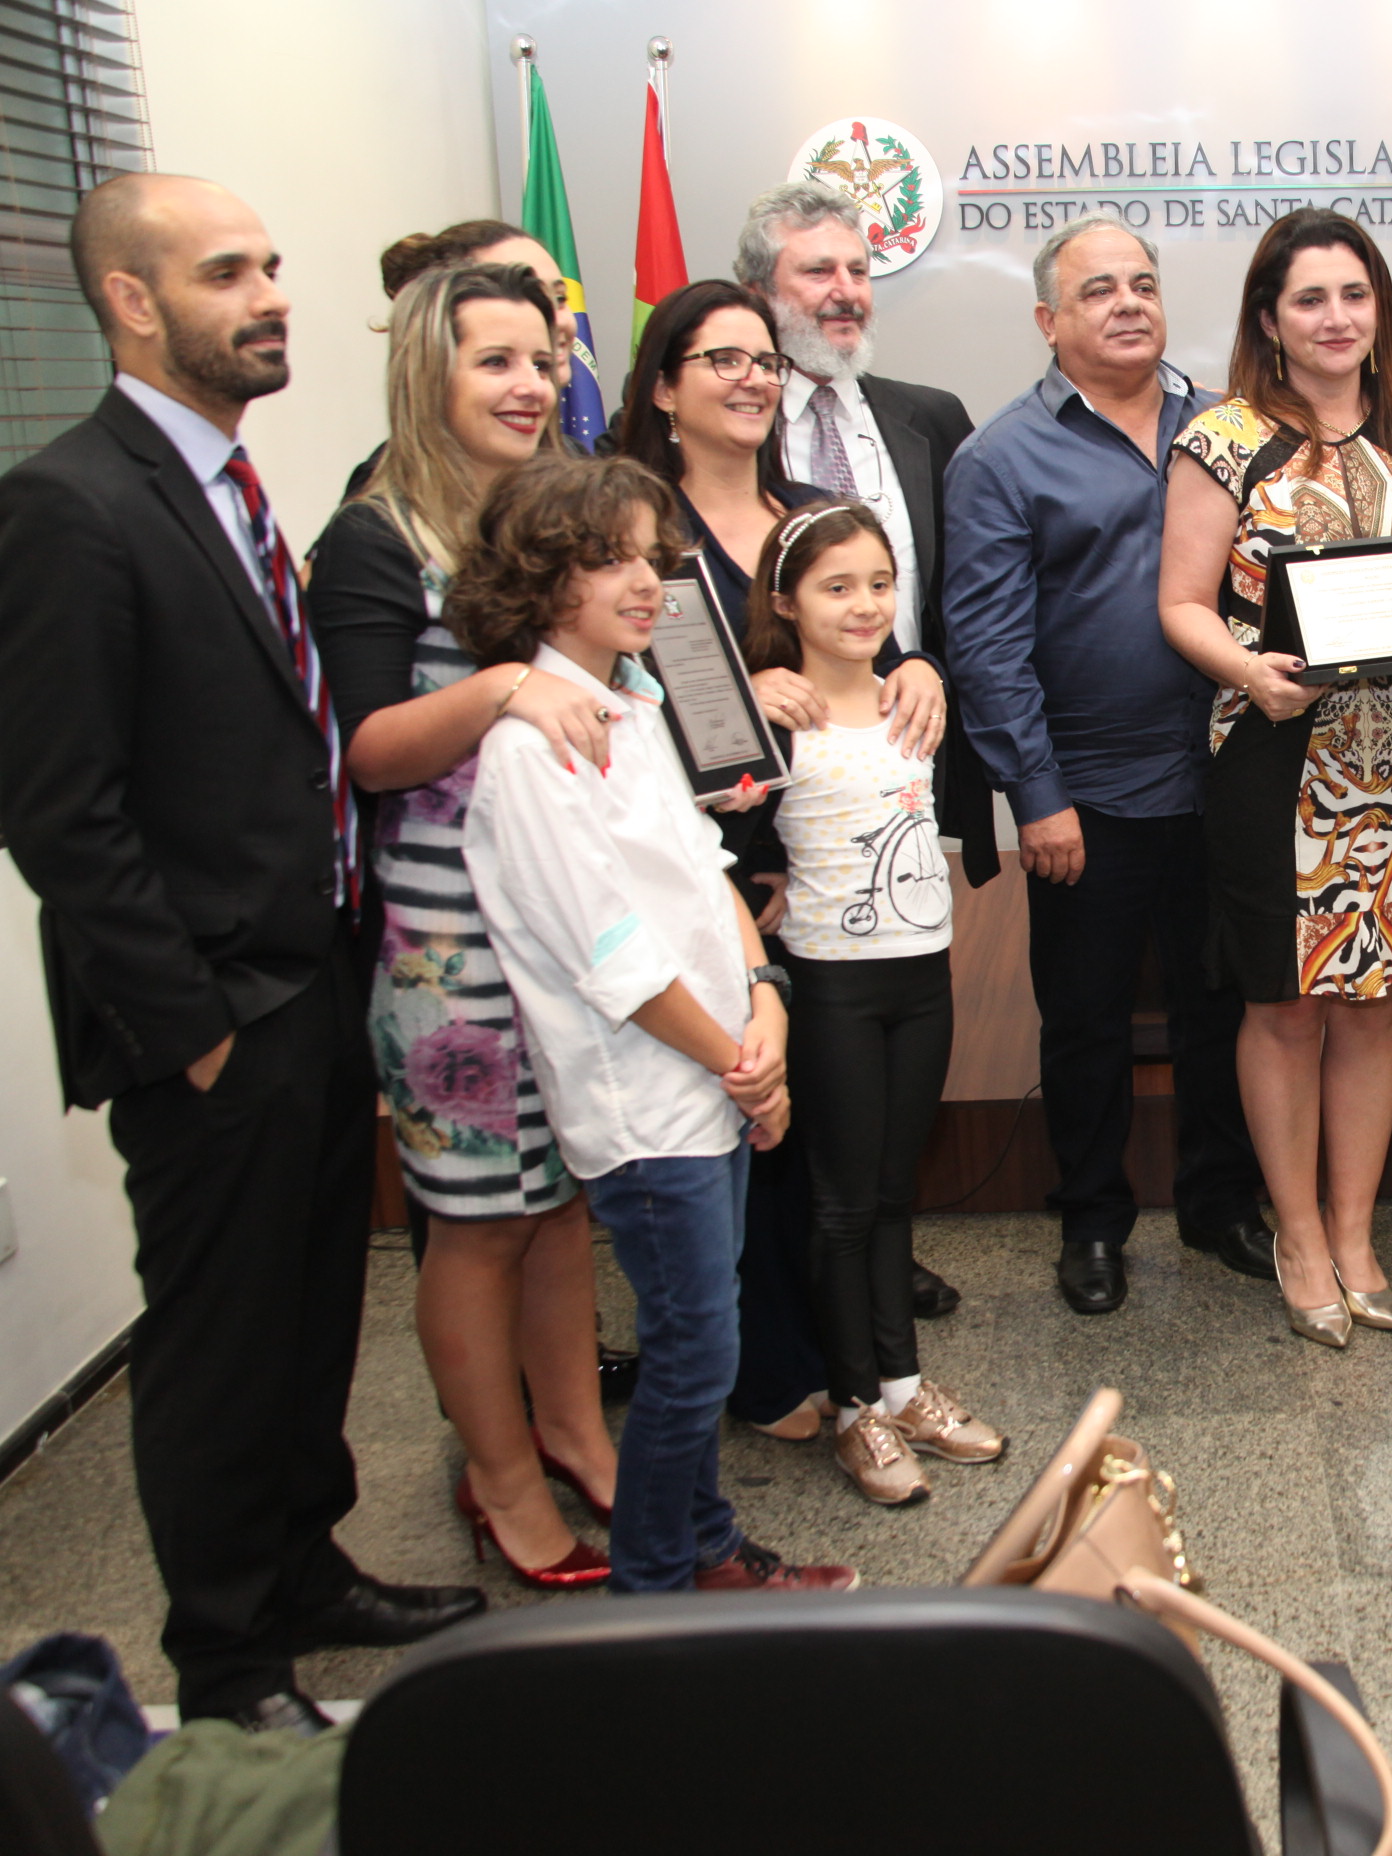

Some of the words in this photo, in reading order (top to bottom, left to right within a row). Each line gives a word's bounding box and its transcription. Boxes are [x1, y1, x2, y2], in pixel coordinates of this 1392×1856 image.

[958, 141, 1217, 180] ASSEMBLEIA
[958, 202, 1012, 230] DO
[1164, 199, 1205, 227] DE
[1217, 198, 1315, 226] SANT
